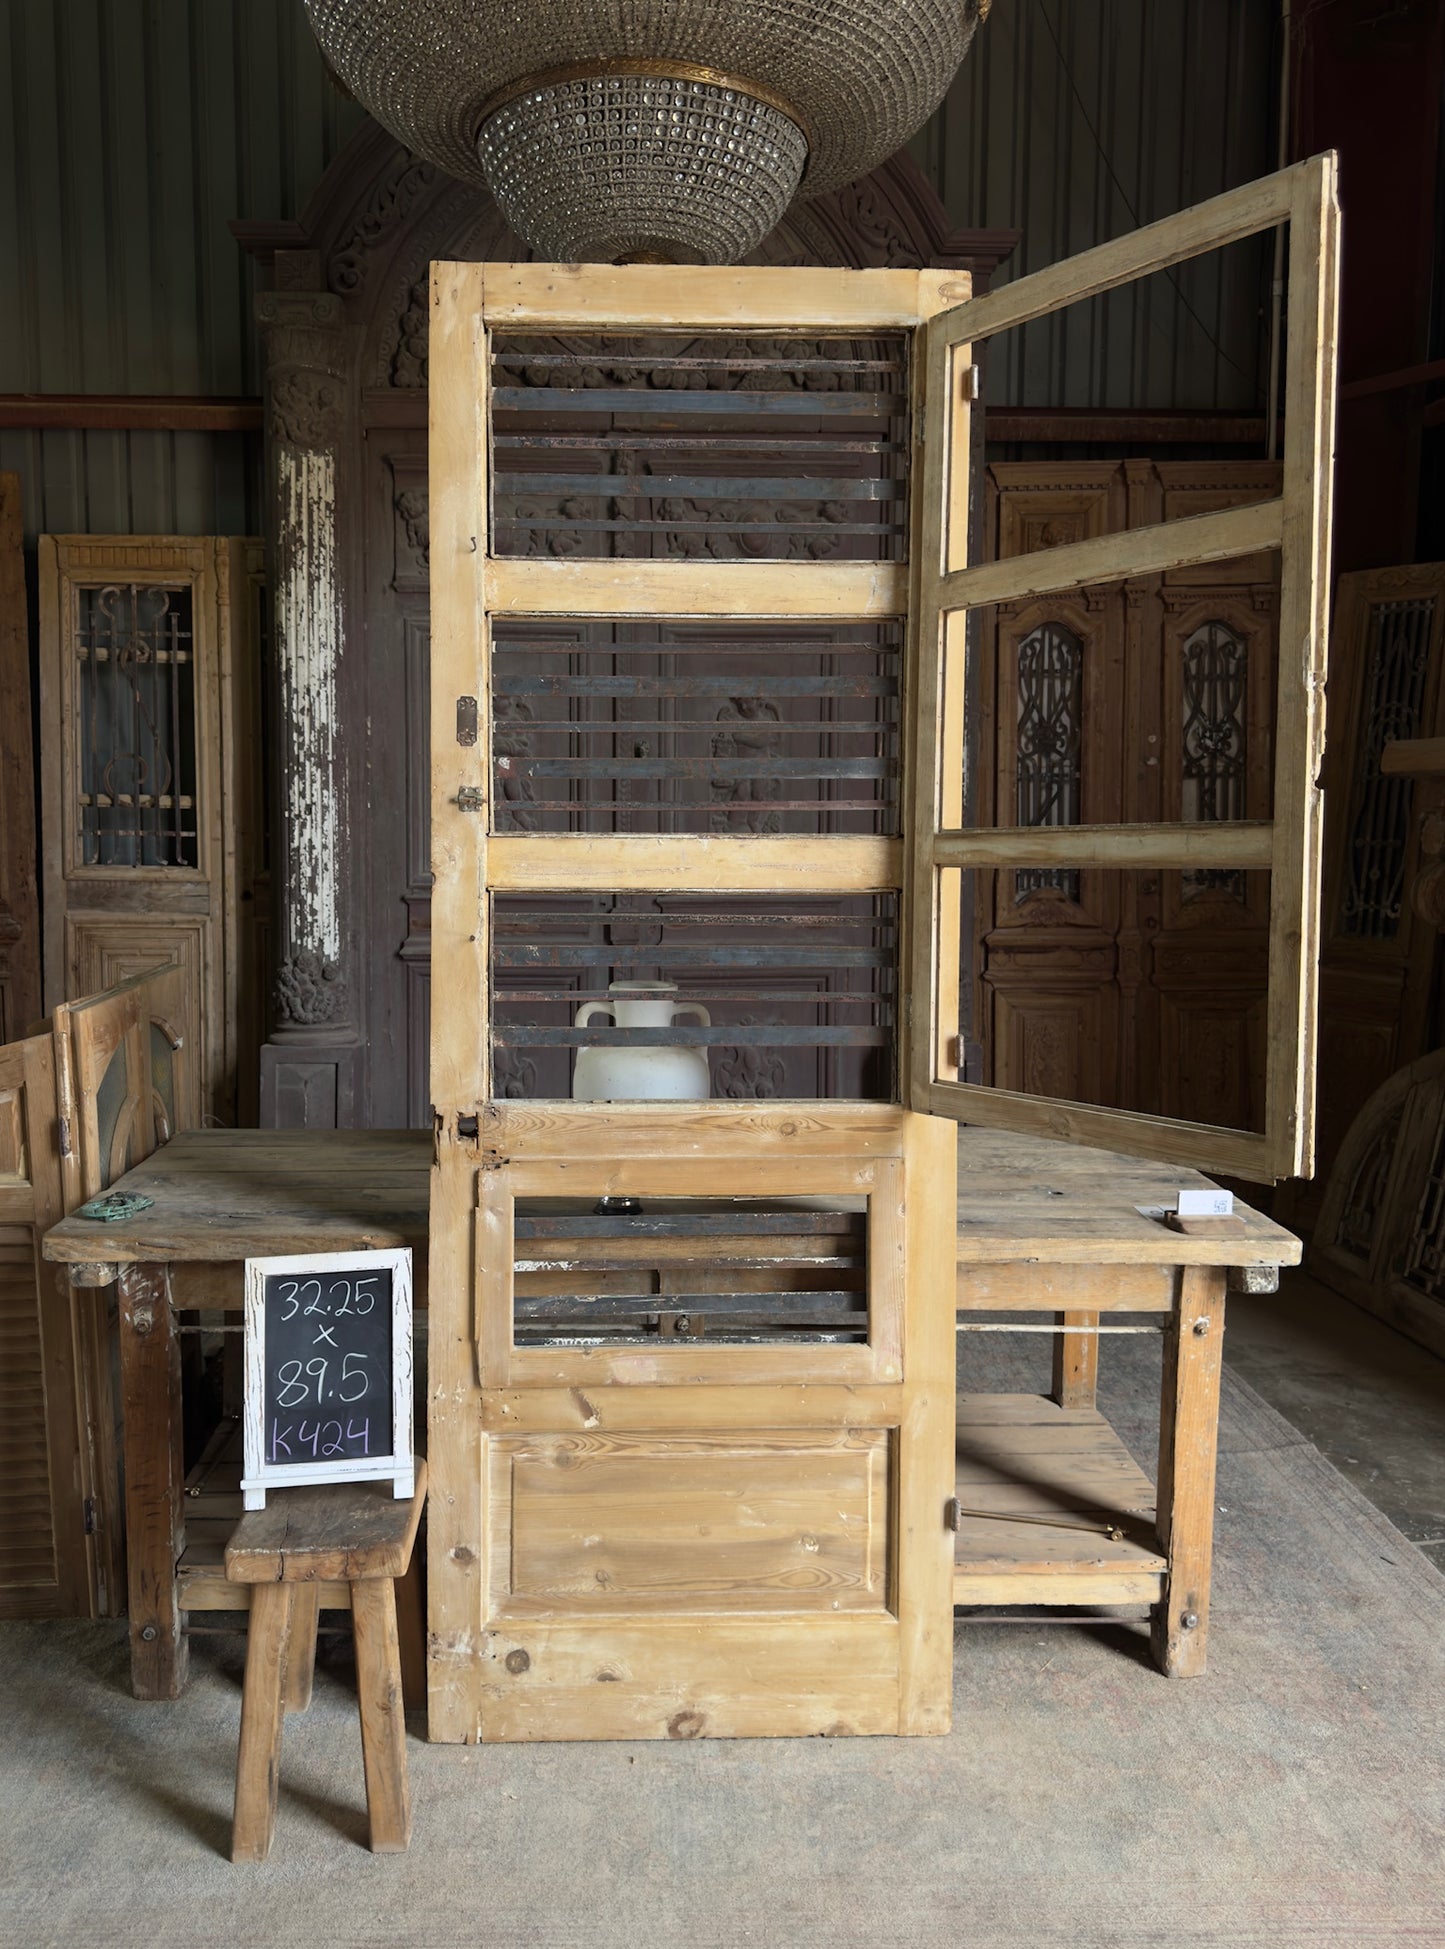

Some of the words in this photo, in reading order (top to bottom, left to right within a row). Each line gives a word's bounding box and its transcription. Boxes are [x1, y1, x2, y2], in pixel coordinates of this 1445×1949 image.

[278, 1277, 379, 1321] 32.25
[276, 1352, 369, 1408] 89.5
[271, 1417, 370, 1462] K424
